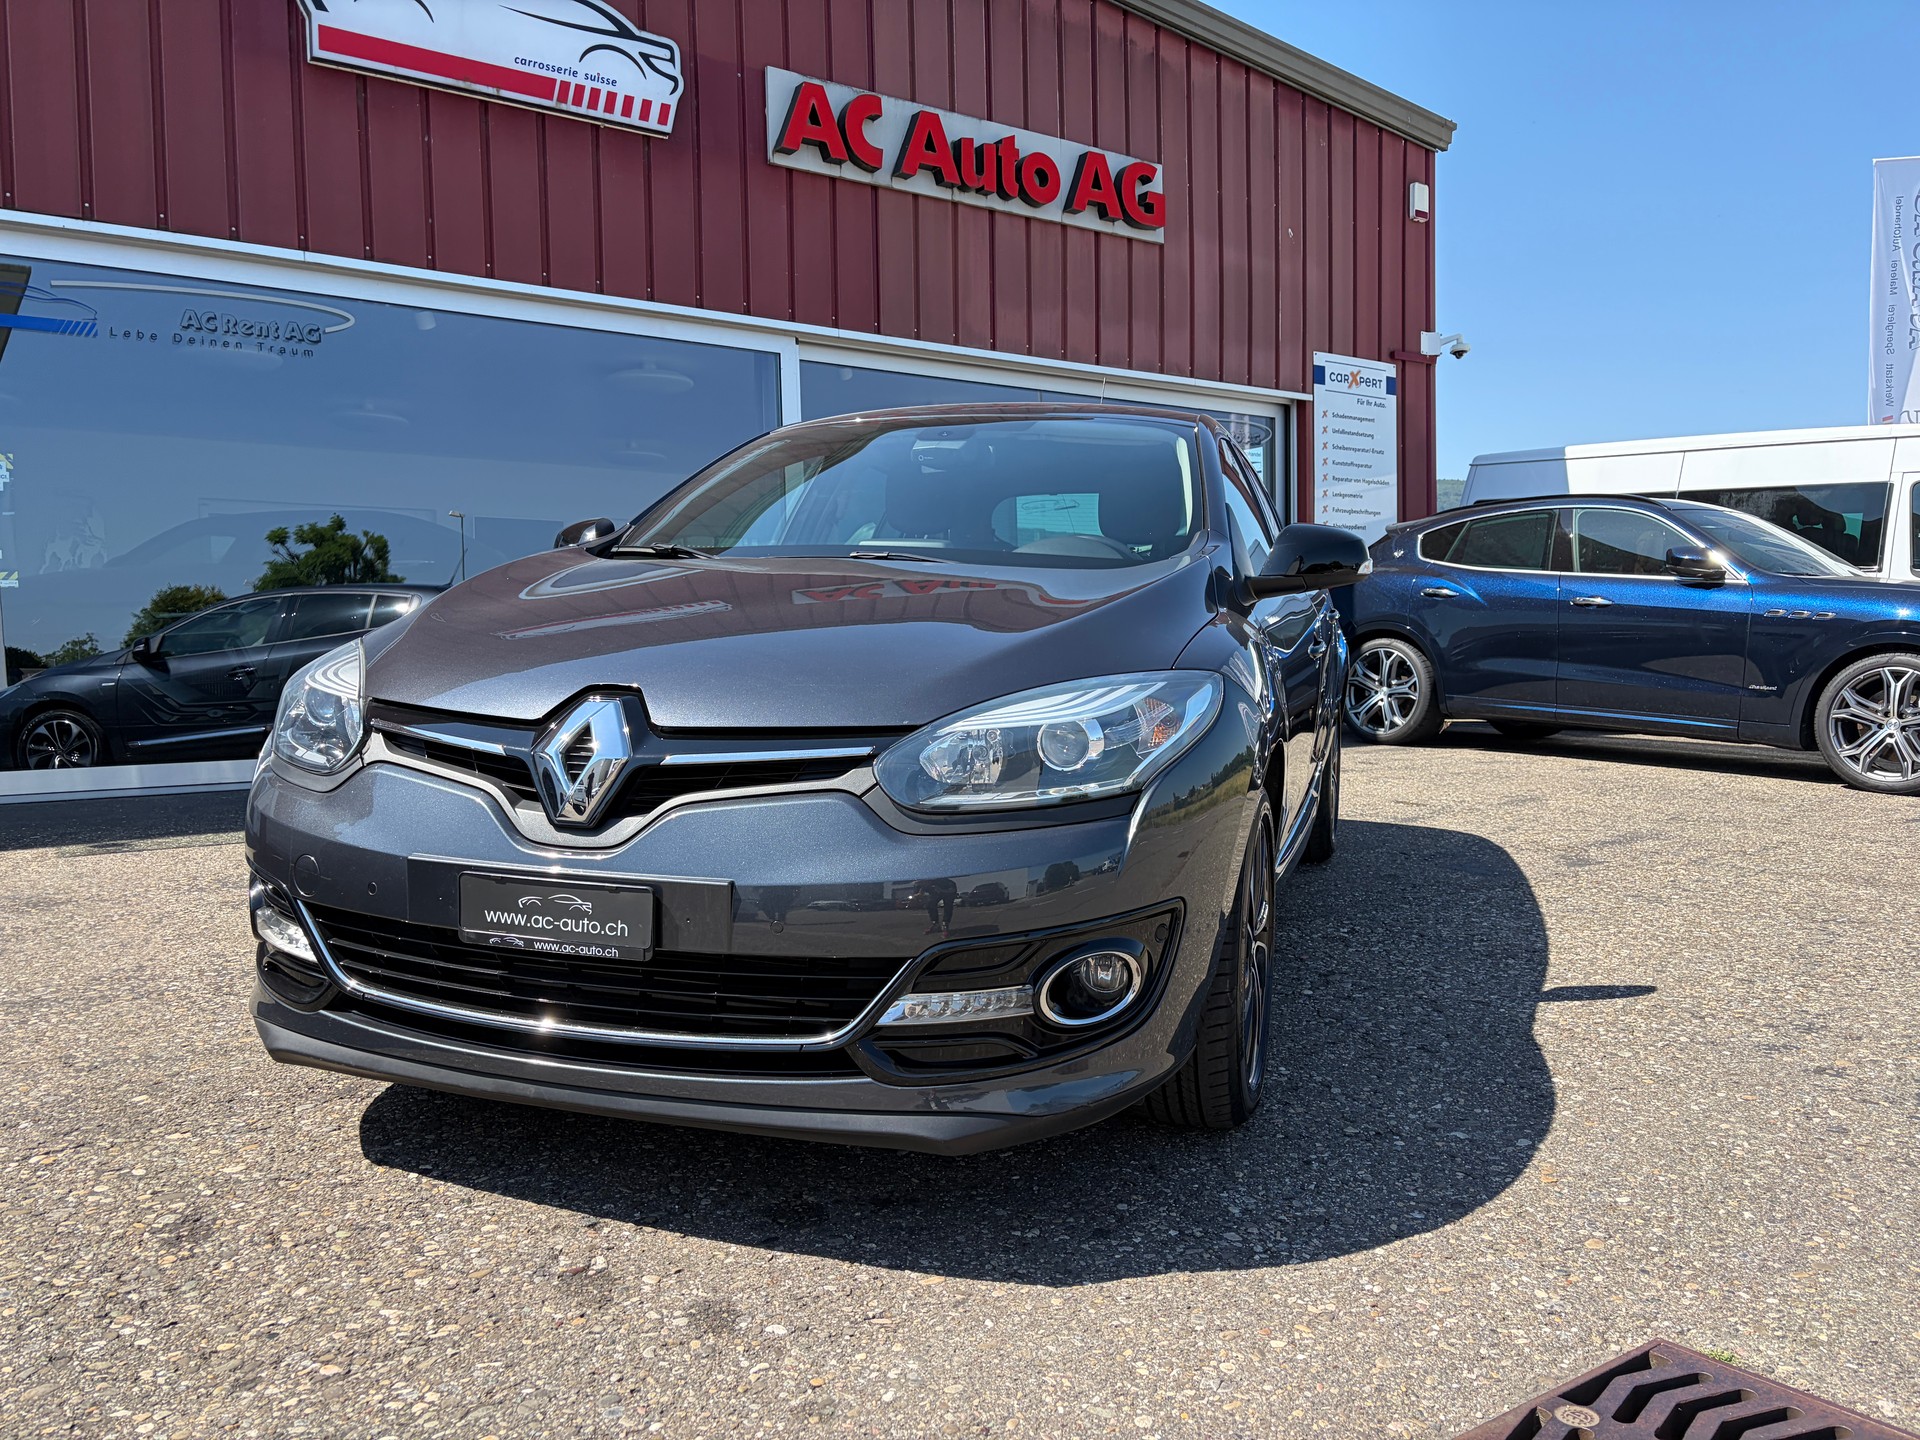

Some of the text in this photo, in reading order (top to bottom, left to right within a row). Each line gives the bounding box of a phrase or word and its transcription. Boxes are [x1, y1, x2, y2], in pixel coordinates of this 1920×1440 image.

[514, 56, 618, 87] carrosserie suisse
[774, 81, 1166, 231] AC Auto AG
[180, 308, 322, 345] AC Rent AG
[109, 326, 314, 357] Lebe Deinen Traum
[1332, 412, 1376, 423] Schadenmanagement
[1356, 398, 1365, 406] Für
[1374, 401, 1387, 409] Auto.
[1332, 475, 1353, 483] Reparatur
[485, 909, 628, 937] www.ac-auto.ch
[534, 940, 618, 958] www.ac-auto.ch
